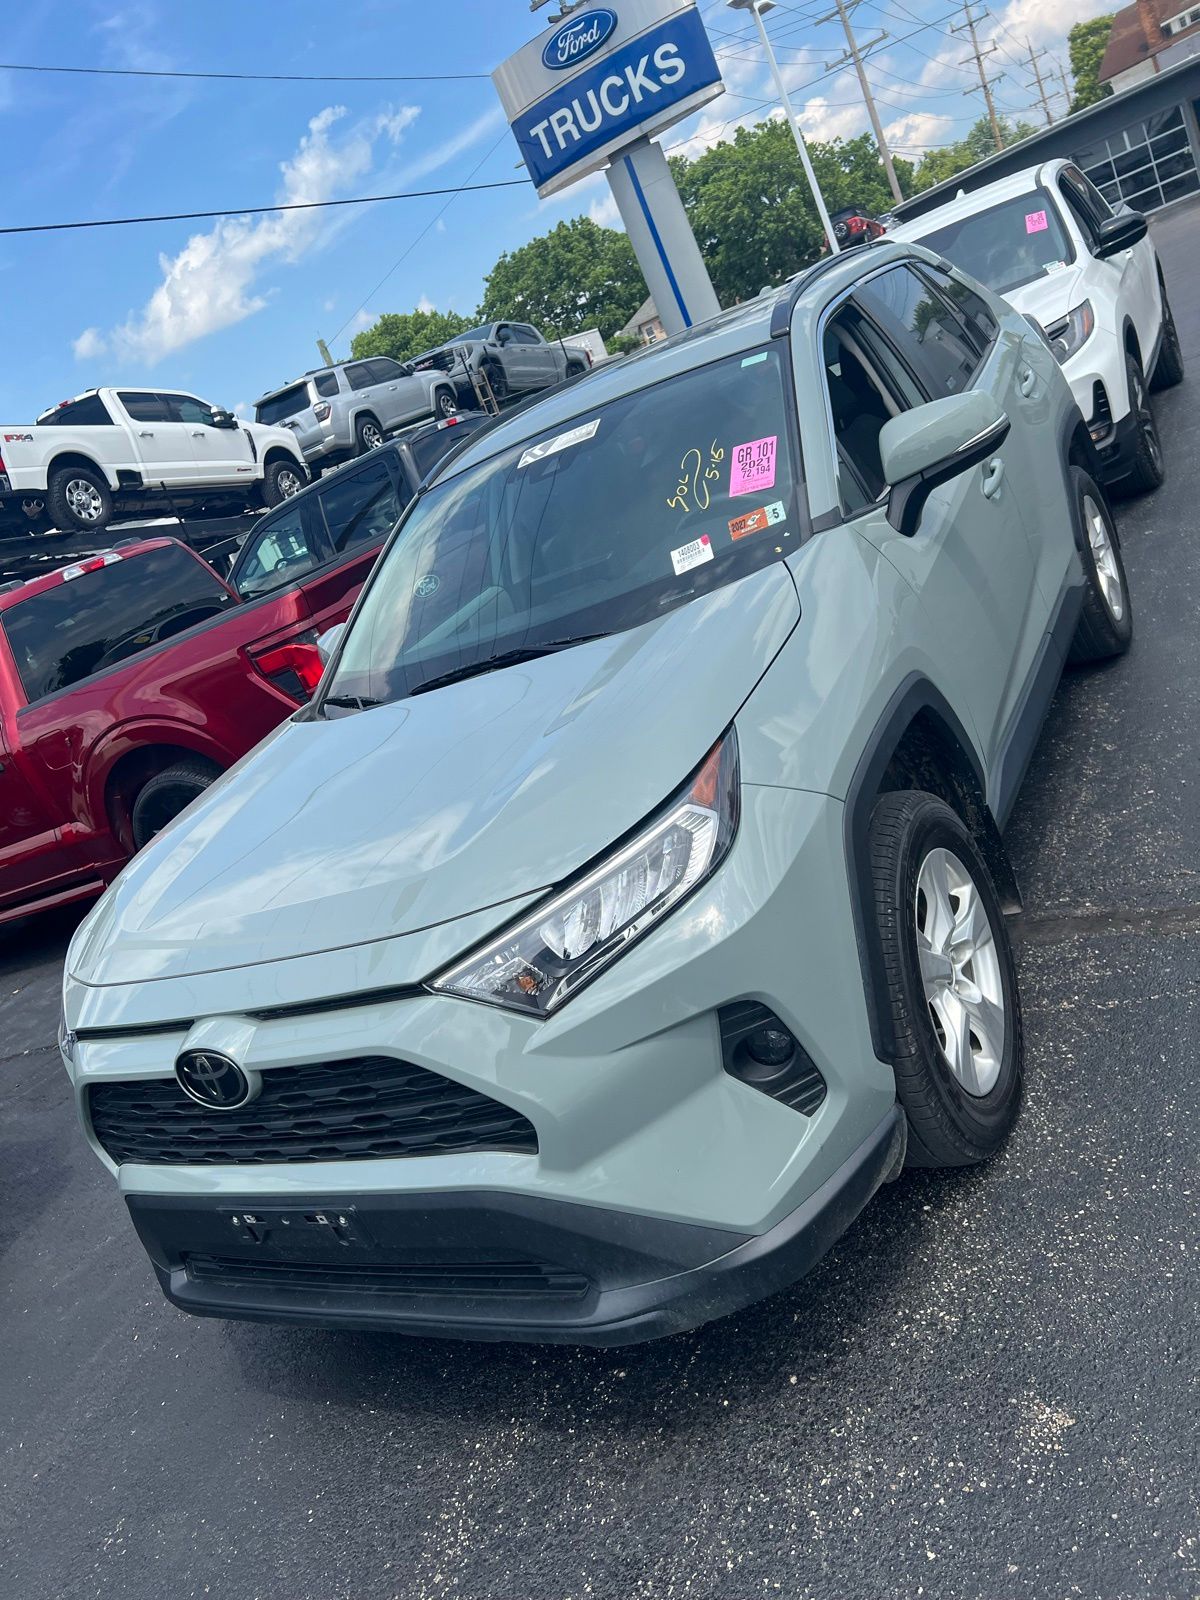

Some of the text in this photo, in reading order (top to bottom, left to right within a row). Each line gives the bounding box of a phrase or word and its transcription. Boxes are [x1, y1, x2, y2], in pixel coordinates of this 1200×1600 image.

[557, 20, 600, 61] Ford
[529, 43, 686, 159] TRUCKS
[737, 441, 774, 464] GR 101
[741, 457, 771, 471] 2021
[742, 464, 771, 479] 72,194
[731, 519, 746, 533] 2027
[772, 508, 780, 519] 5
